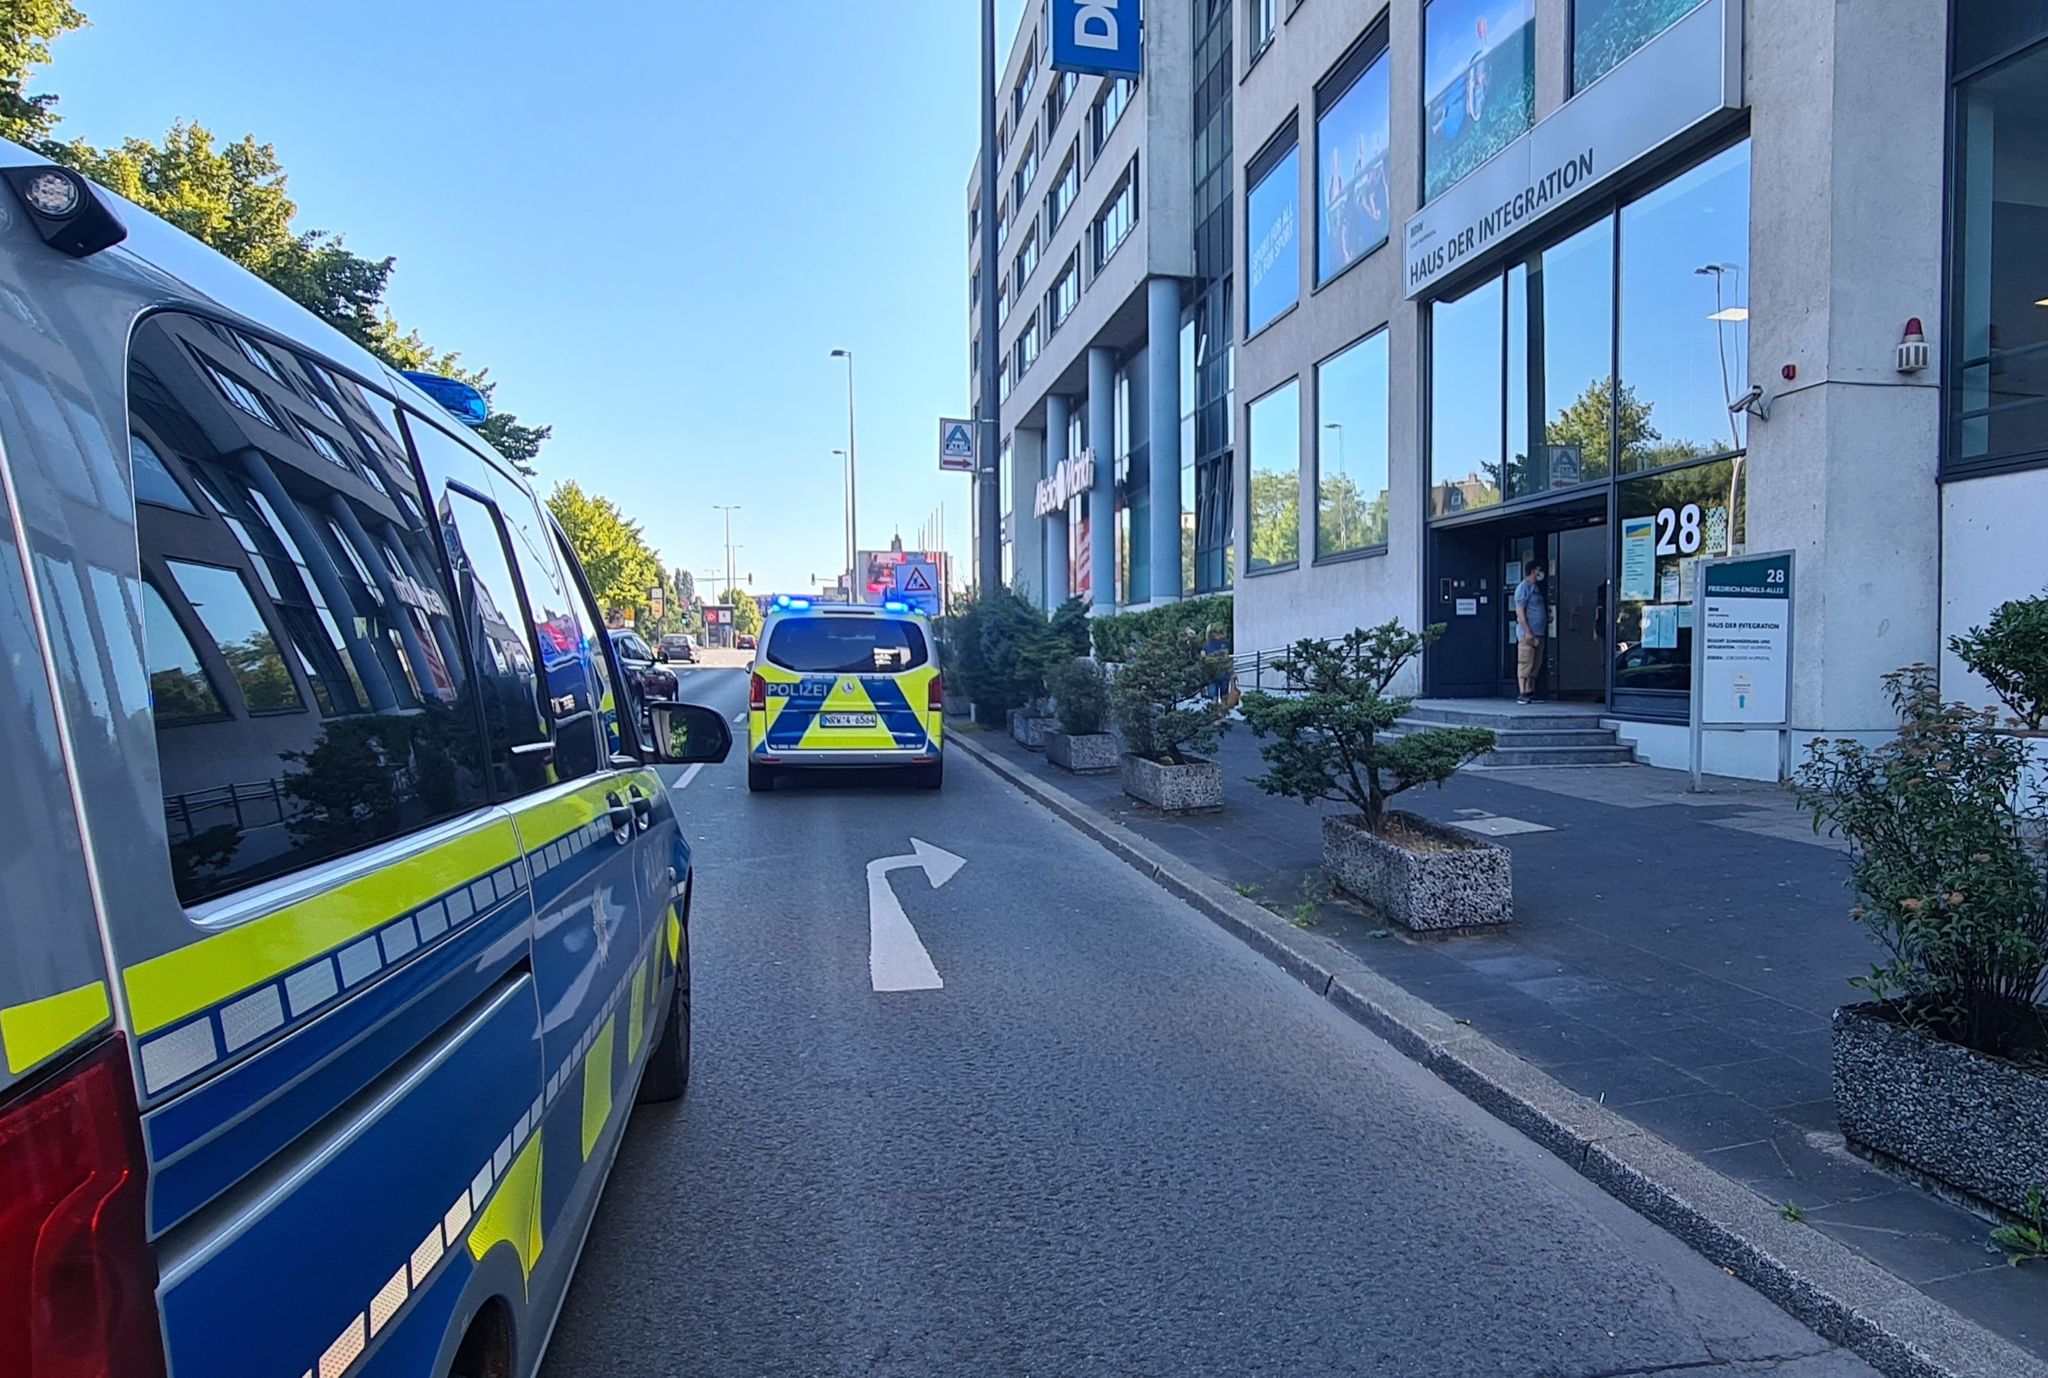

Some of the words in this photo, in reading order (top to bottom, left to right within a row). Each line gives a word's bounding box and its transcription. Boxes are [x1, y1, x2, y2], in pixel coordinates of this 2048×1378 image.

[1410, 246, 1444, 286] HAUS
[1448, 226, 1474, 263] DER
[1479, 147, 1593, 244] INTEGRATION
[1656, 503, 1701, 556] 28
[1766, 569, 1785, 583] 28
[1707, 585, 1784, 594] FRIEDRICH-ENGELS-ALLEE
[1738, 622, 1780, 630] INTEGRATION
[767, 683, 827, 697] POLIZEI
